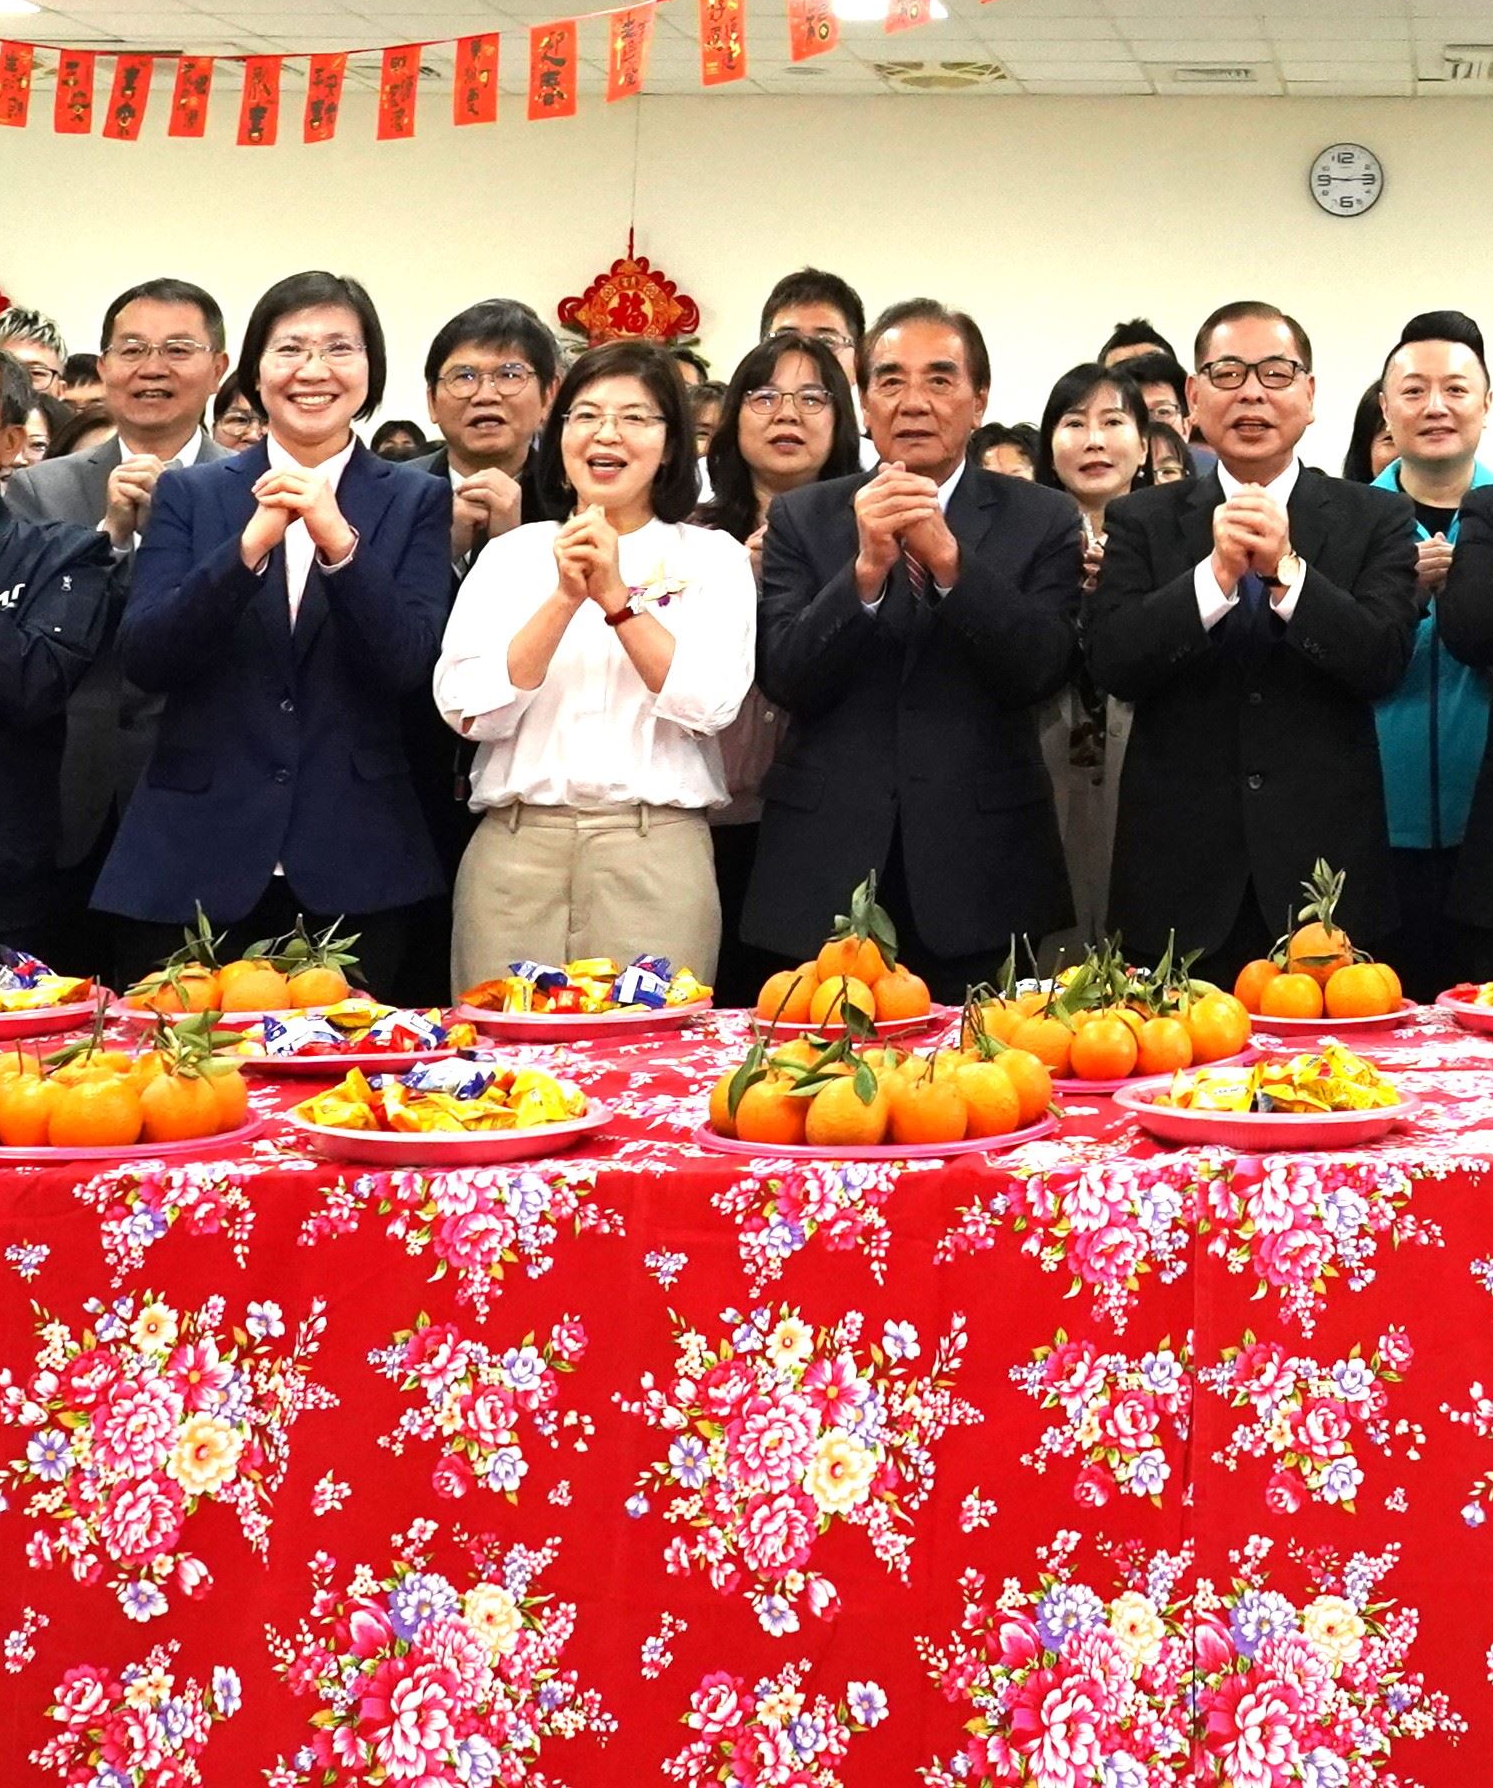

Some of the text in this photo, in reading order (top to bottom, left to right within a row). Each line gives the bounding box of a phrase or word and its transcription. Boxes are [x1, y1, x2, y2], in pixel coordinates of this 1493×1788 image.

[1338, 152, 1354, 164] 12
[1340, 196, 1353, 207] 6
[608, 292, 648, 333] 福
